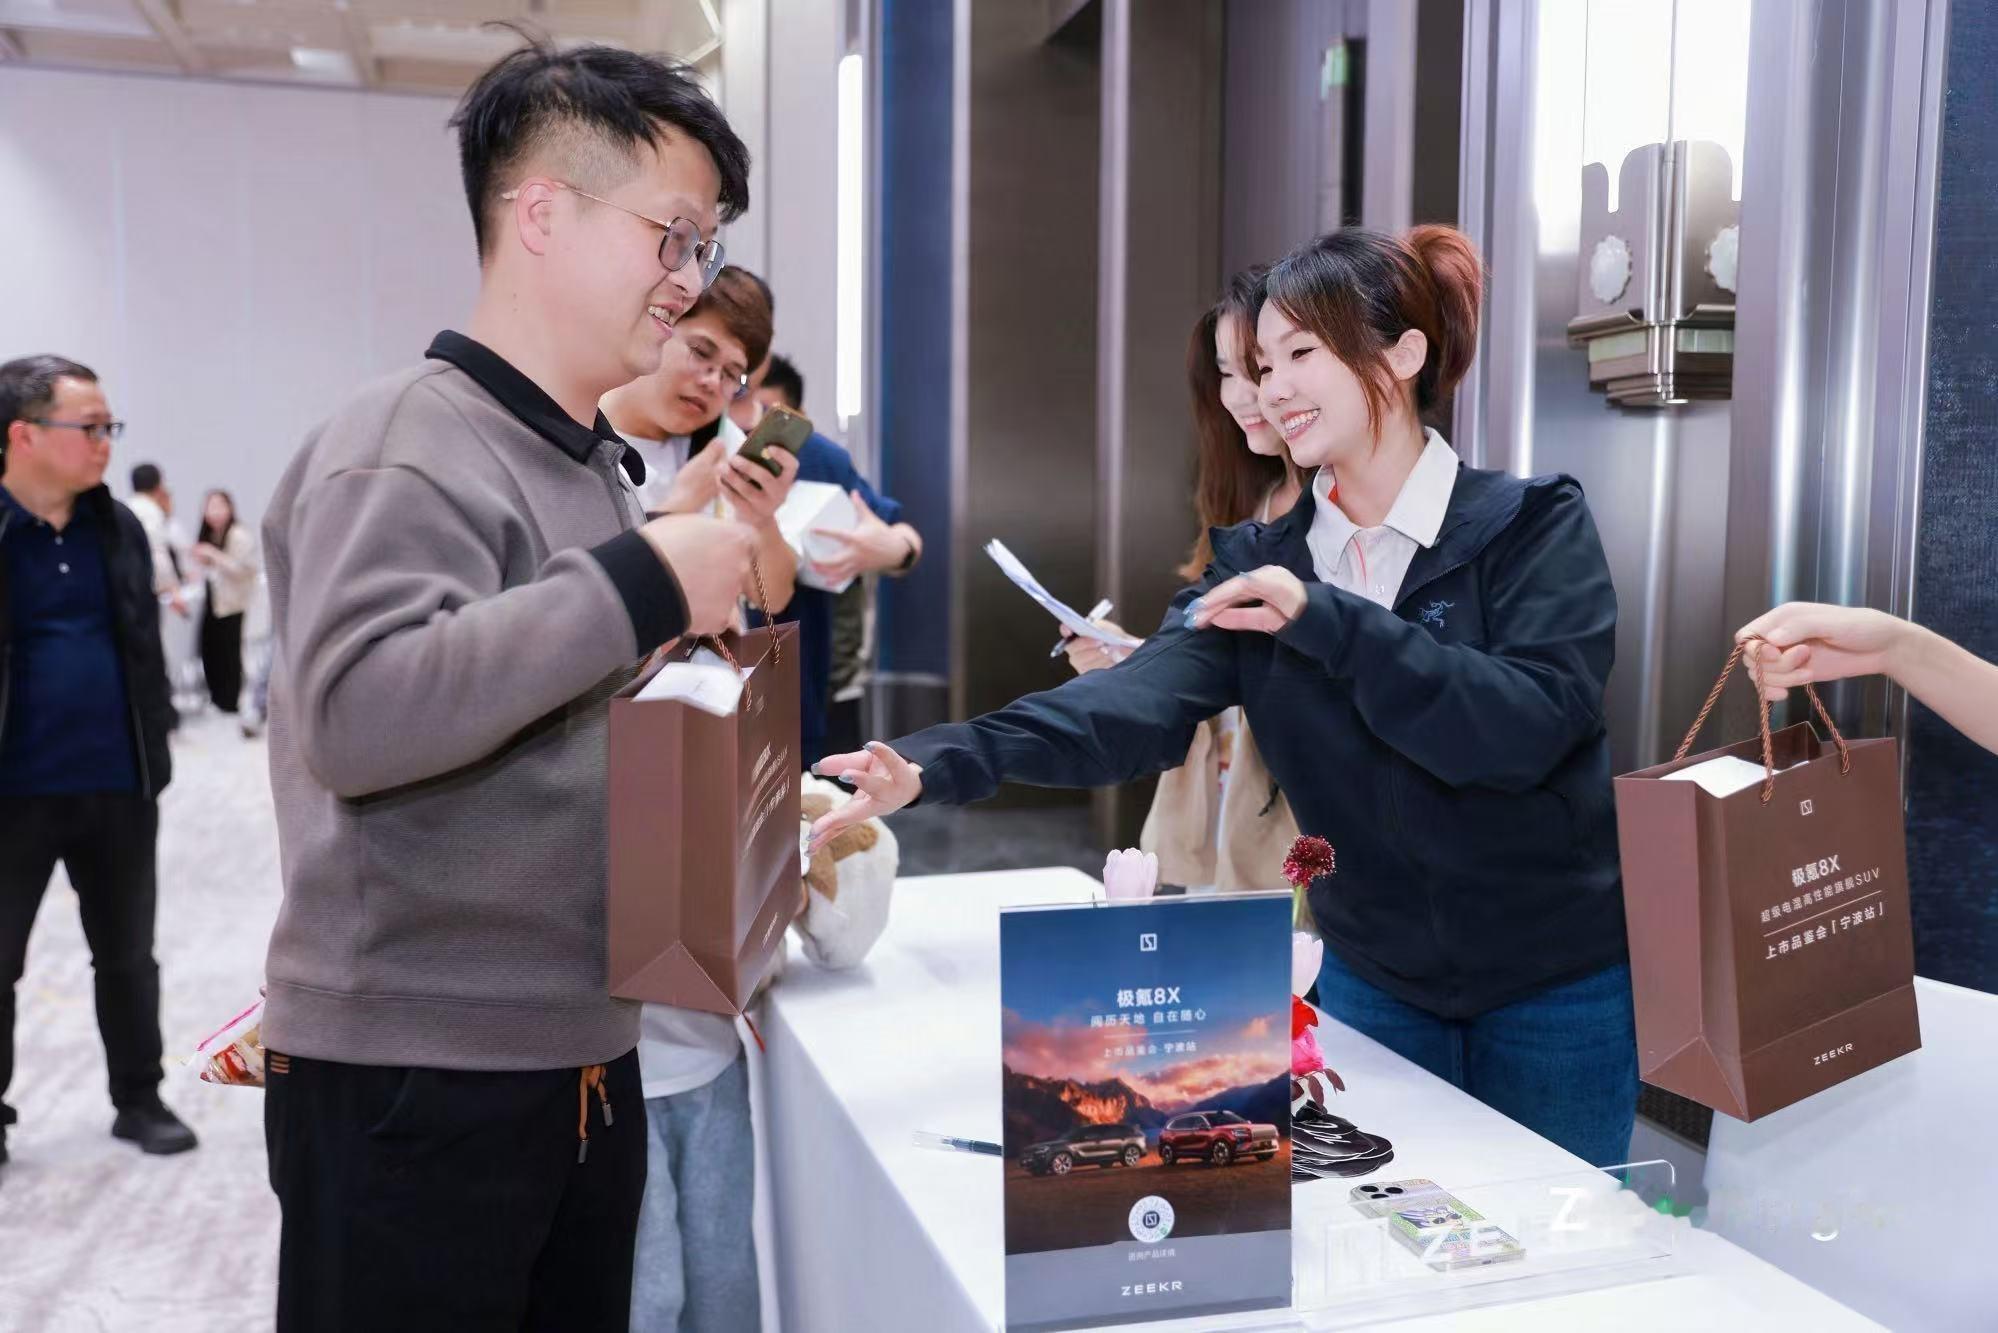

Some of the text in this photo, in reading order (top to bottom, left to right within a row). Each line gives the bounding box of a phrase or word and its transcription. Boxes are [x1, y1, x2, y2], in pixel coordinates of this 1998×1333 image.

[1792, 855, 1840, 887] 极氪8X
[1116, 986, 1181, 1008] 极氪8X
[1813, 1043, 1854, 1065] ZEEKR
[1121, 1281, 1183, 1297] ZEEKR
